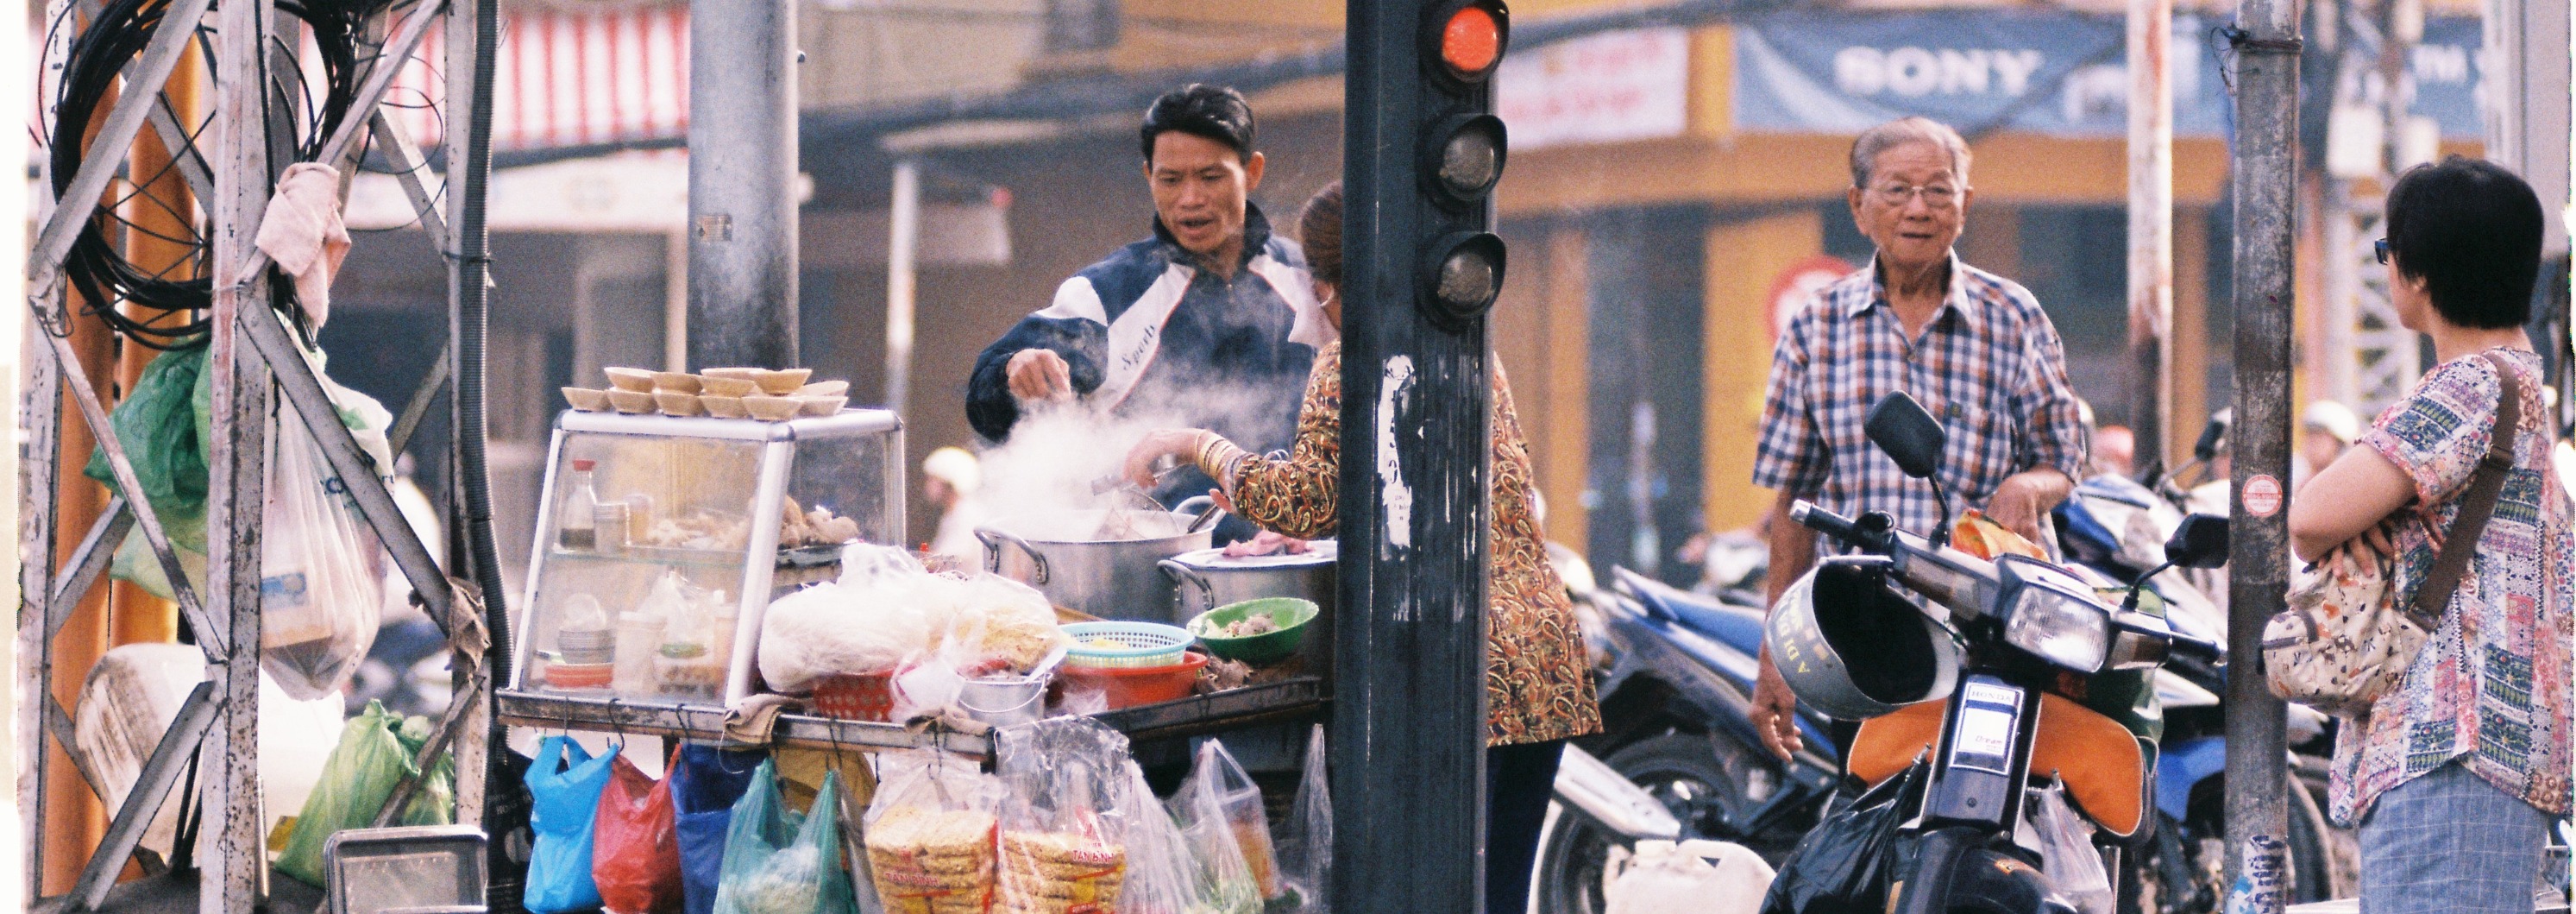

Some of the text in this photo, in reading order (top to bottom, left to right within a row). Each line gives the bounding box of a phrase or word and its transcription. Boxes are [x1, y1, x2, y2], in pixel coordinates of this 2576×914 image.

[1834, 45, 2044, 95] SONY
[1971, 690, 2012, 703] HONDA
[1975, 734, 2003, 745] Dream
